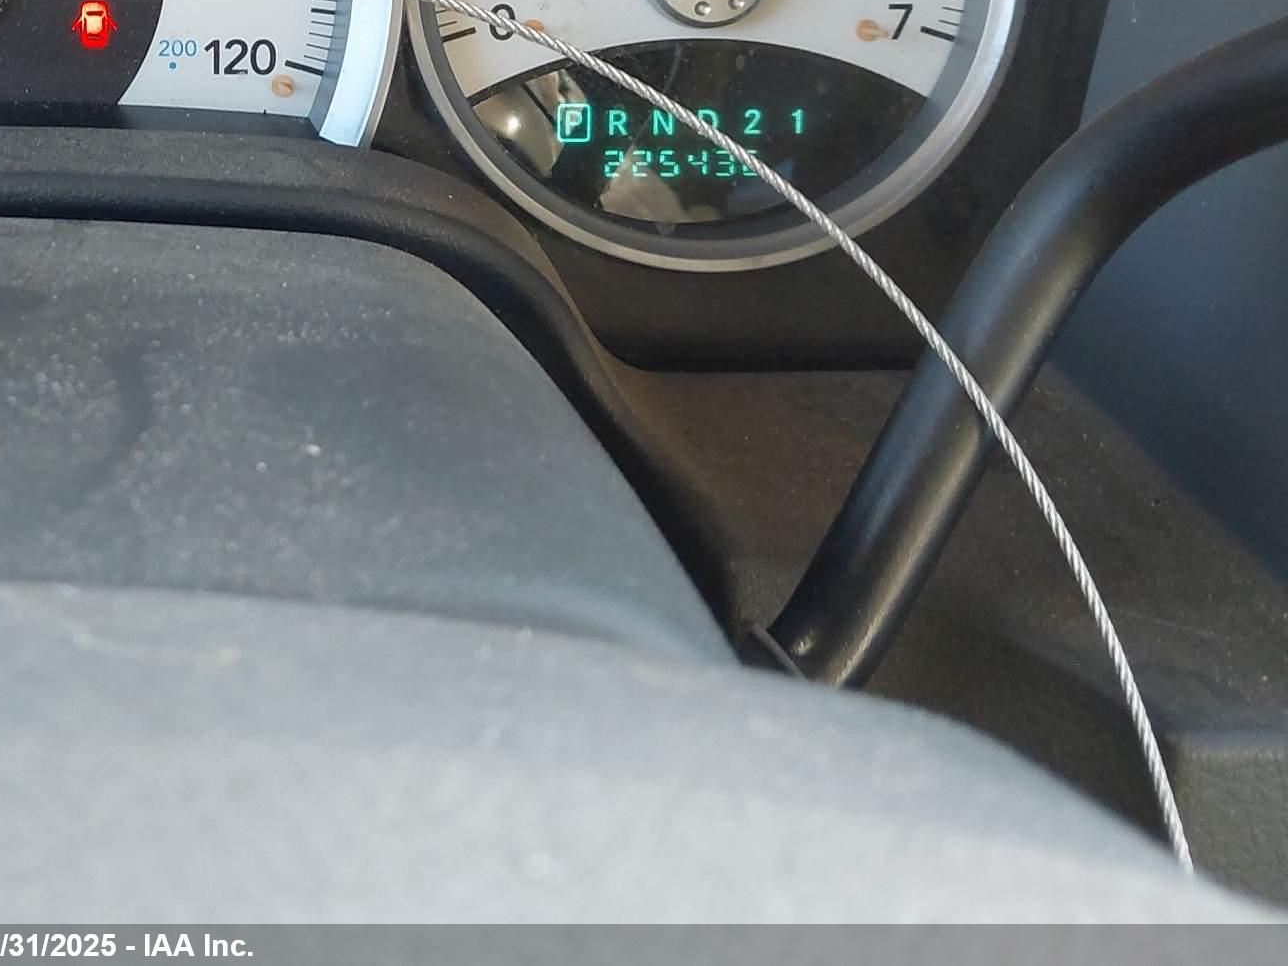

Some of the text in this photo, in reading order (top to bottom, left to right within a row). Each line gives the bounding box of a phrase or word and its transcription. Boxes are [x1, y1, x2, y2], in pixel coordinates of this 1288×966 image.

[888, 3, 913, 40] 7
[158, 39, 197, 57] 200
[204, 39, 277, 76] 120
[564, 111, 583, 136] P
[608, 110, 628, 135] R
[652, 110, 673, 135] N
[744, 109, 761, 135] 2
[790, 109, 805, 134] 1
